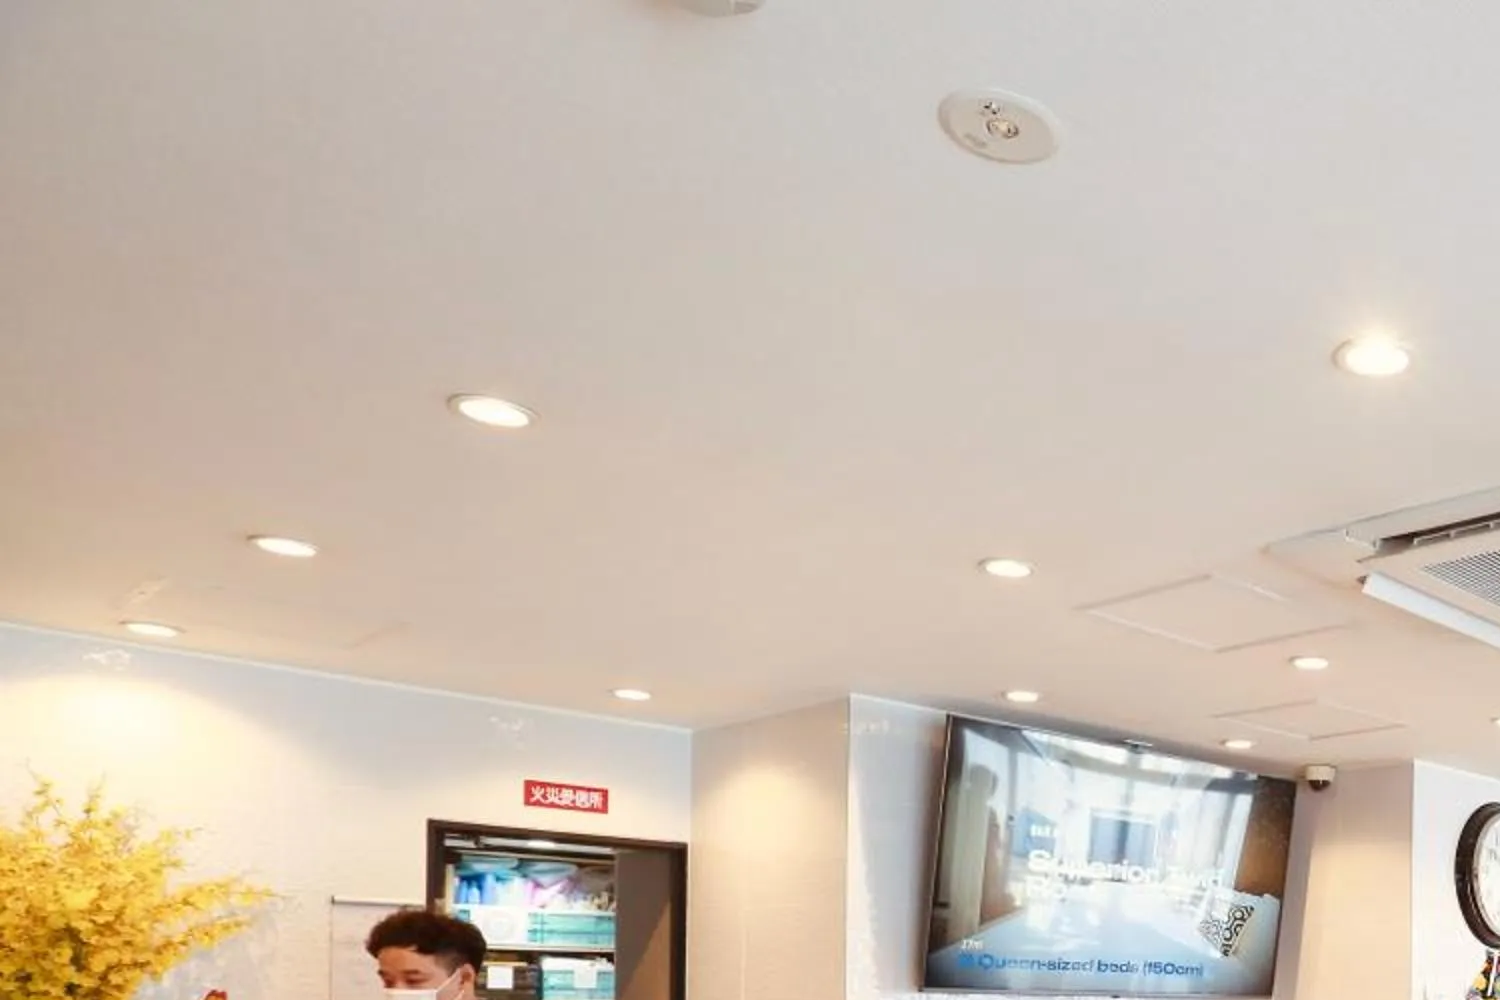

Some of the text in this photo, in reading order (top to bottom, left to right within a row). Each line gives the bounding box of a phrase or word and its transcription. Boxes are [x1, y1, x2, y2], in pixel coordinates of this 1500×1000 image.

[978, 953, 1205, 977] Queen-sized beds (150cm)
